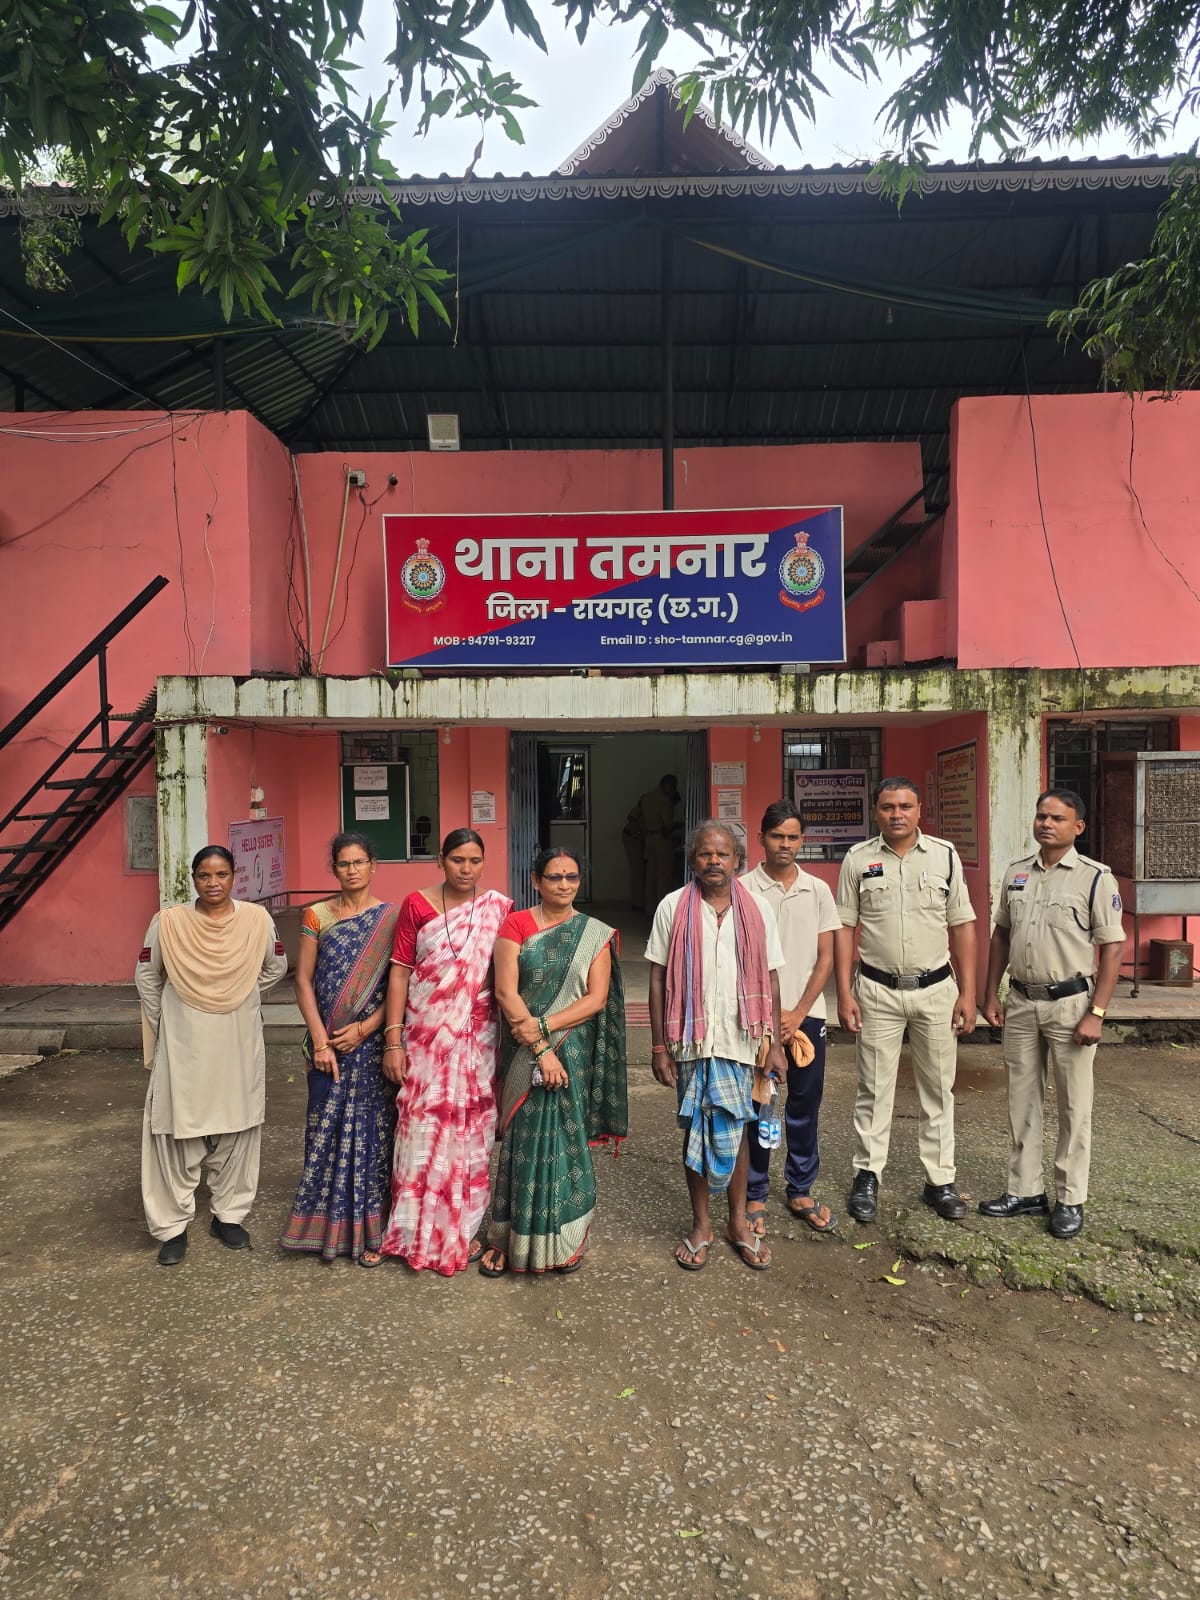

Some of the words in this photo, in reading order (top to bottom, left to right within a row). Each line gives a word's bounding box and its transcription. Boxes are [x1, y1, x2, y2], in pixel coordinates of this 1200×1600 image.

[455, 537, 579, 581] थाना
[586, 533, 770, 580] तमनार
[486, 591, 550, 620] जिला
[571, 597, 653, 626] रायगढ़
[658, 592, 739, 625] (छ.ग.)
[433, 636, 460, 646] MOB
[467, 635, 536, 646] 94791-93217
[600, 635, 633, 646] Email
[635, 635, 647, 645] ID
[654, 632, 793, 646] sho-tamnar.cg@gov.in
[839, 775, 863, 789] पुलिस
[241, 836, 257, 853] HELLO
[257, 833, 274, 850] SISTER
